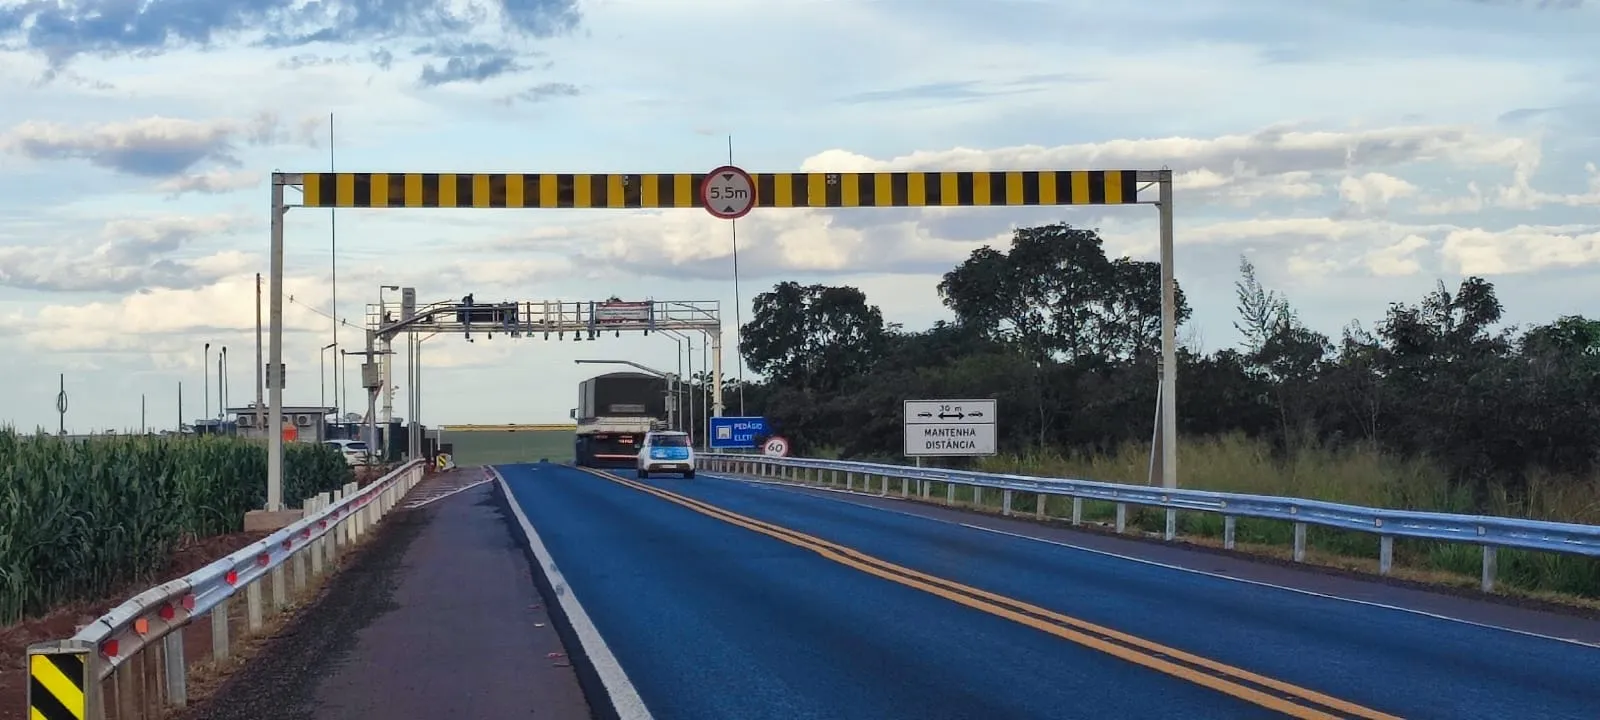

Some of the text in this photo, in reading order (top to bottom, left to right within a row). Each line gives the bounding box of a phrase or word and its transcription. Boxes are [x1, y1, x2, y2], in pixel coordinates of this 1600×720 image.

[710, 187, 748, 199] 5,5m
[734, 421, 762, 430] PEDÁGIO
[924, 428, 976, 437] MANTENHA
[768, 443, 783, 453] 60
[926, 438, 976, 449] DISTÂNCIA
